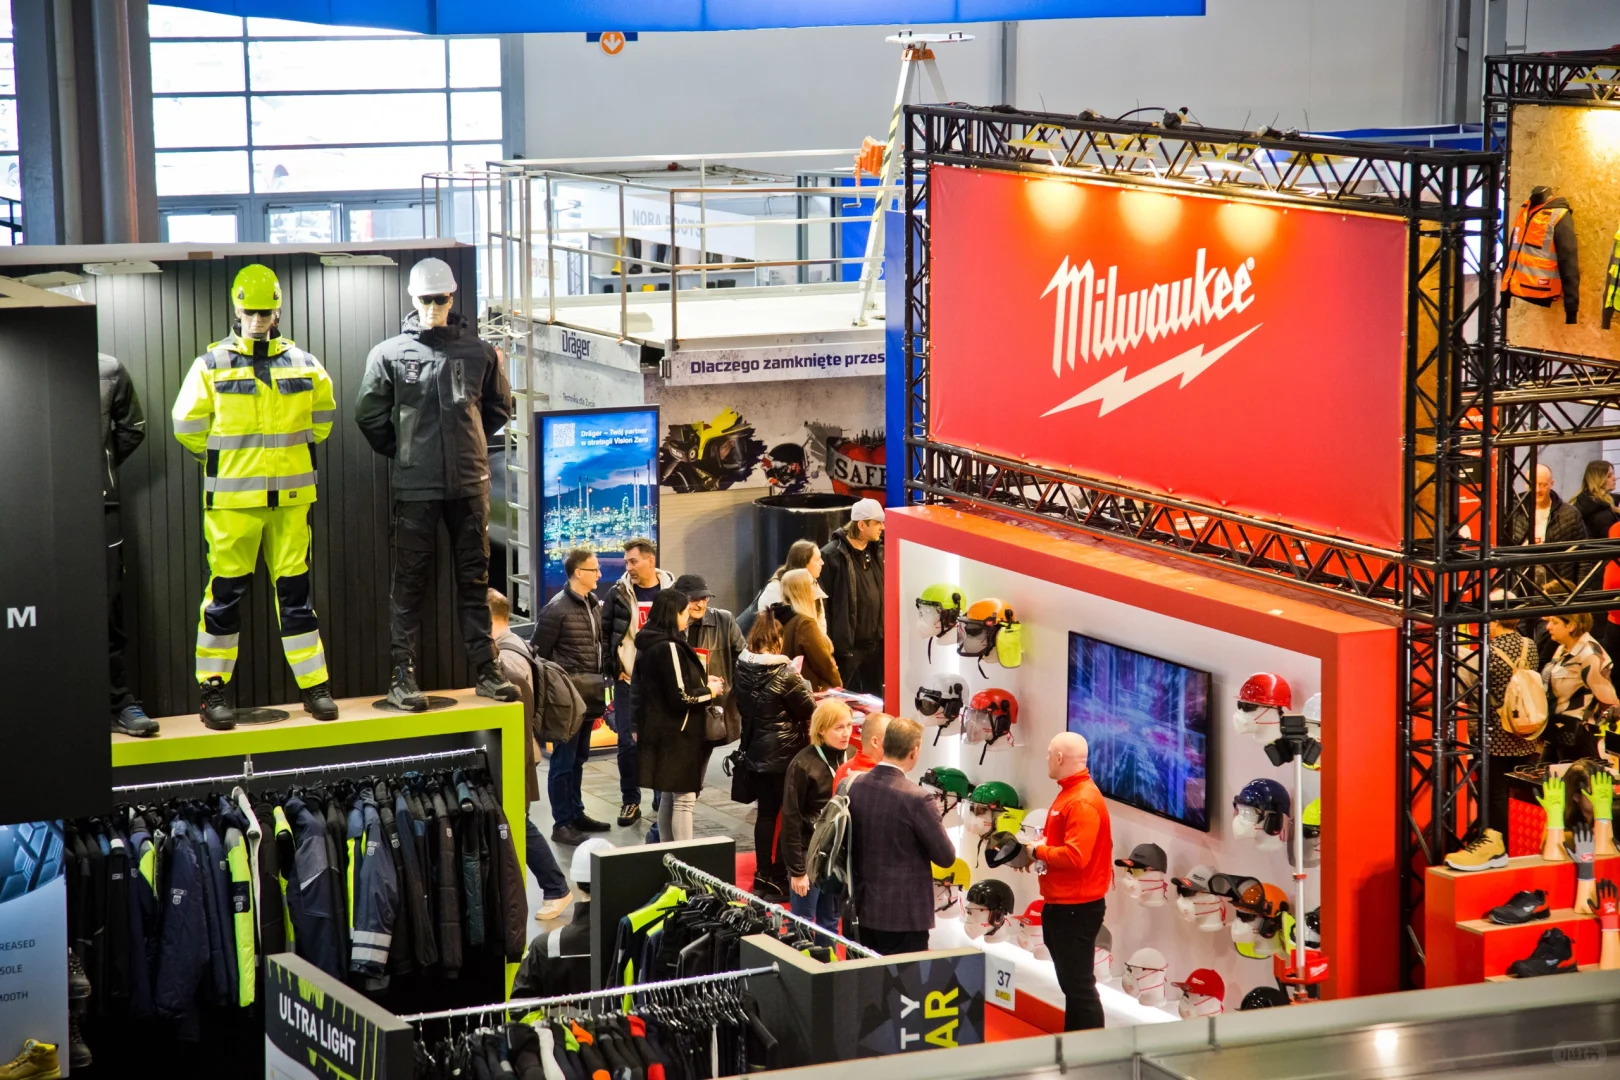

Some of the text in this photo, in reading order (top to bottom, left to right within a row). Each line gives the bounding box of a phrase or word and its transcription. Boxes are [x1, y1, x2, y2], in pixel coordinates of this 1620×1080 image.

[633, 208, 662, 226] NORA
[562, 330, 591, 359] Dräger
[690, 353, 886, 374] Dlaczego zamknięte przes
[581, 430, 603, 438] Dräger
[609, 428, 624, 436] Twój
[624, 427, 648, 436] partner
[633, 436, 649, 444] Zero
[7, 605, 37, 629] M
[0, 964, 23, 976] SOLE
[997, 969, 1012, 988] 37
[279, 992, 357, 1066] ULTRA LIGHT
[900, 994, 920, 1050] TY
